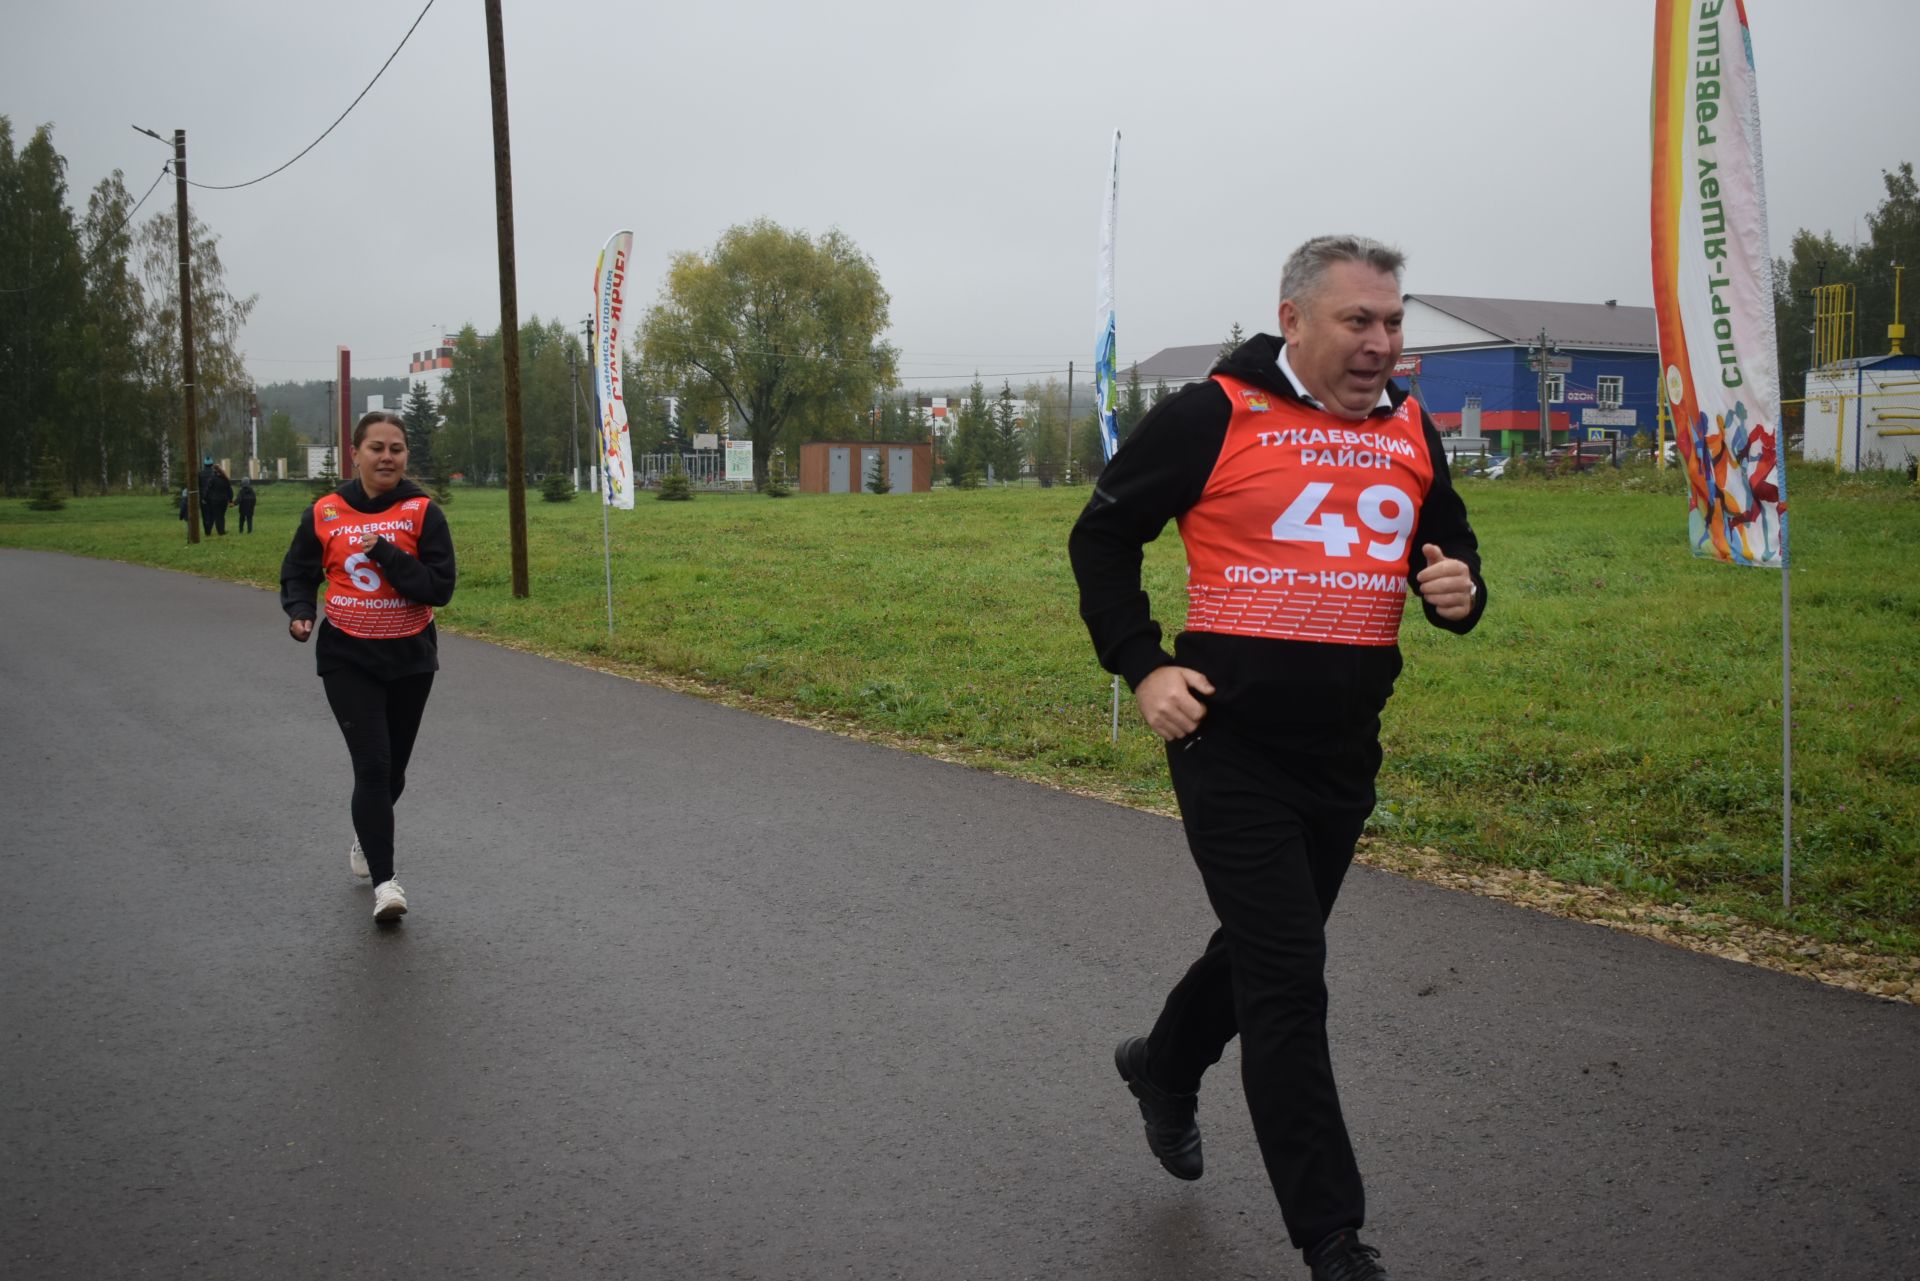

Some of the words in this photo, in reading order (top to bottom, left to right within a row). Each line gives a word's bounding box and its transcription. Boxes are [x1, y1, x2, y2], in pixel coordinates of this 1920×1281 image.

[602, 269, 613, 333] СПОРТОМ
[1256, 427, 1416, 460] ТУКАЕВСКИЙ
[1300, 445, 1391, 470] РАЙОН
[329, 519, 414, 537] ТУКАЕВСКИЙ
[1271, 481, 1415, 562] 49
[1224, 565, 1298, 586] СПОРТ
[1320, 570, 1395, 593] НОРМА
[330, 594, 358, 608] СПОРТ
[365, 598, 407, 609] НОРМА
